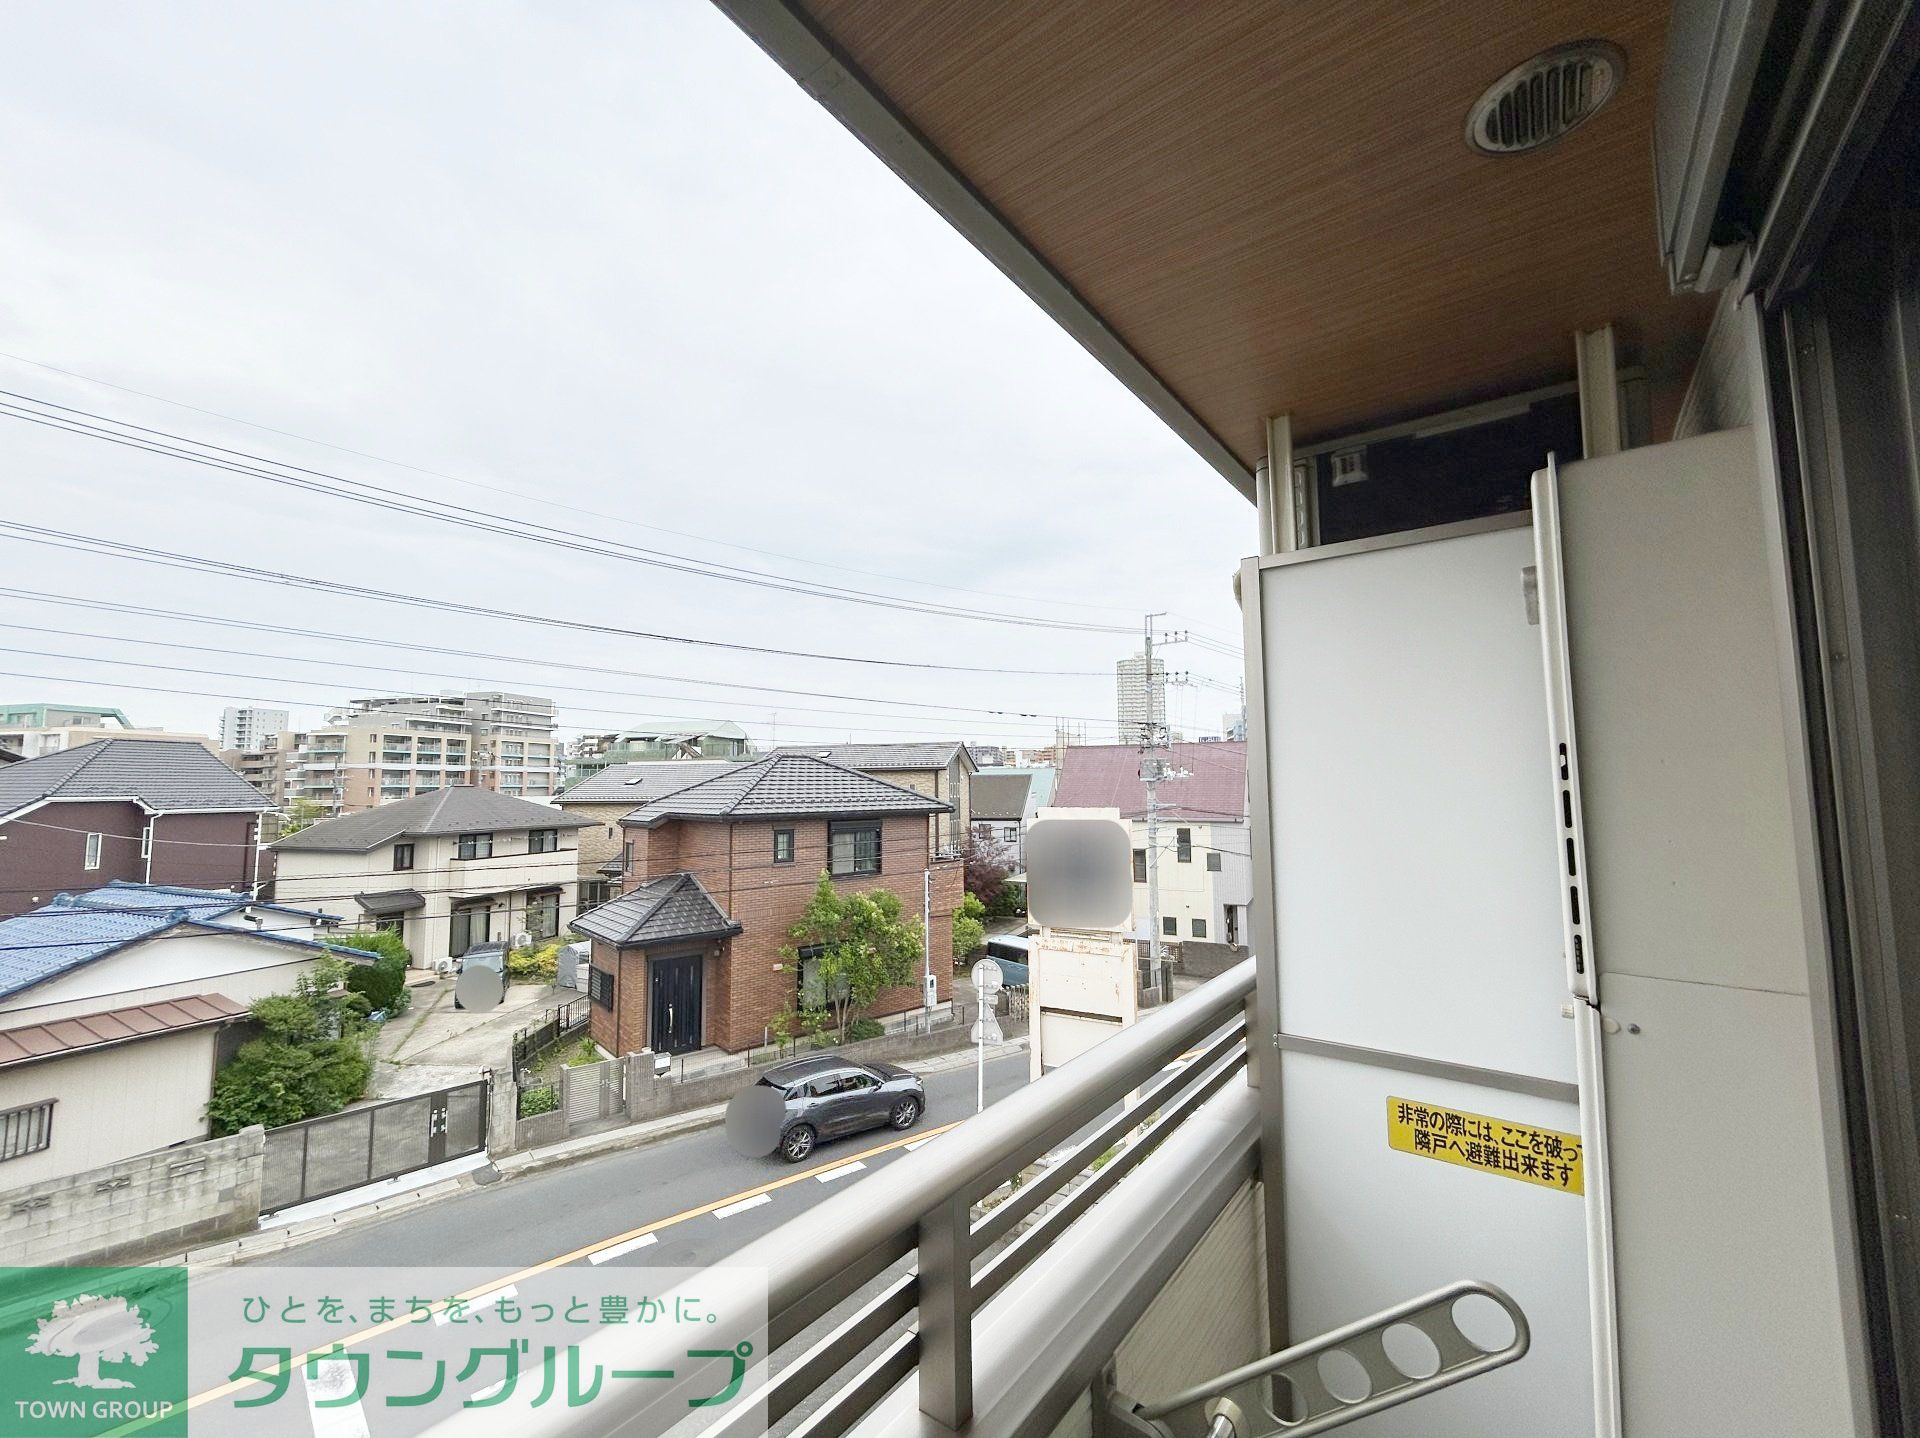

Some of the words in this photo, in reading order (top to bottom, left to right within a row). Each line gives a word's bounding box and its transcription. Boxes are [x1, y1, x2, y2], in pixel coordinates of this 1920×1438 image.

[1397, 1103, 1582, 1161] 非常の際には、ここを破っ
[1414, 1128, 1574, 1186] 隣戸へ避難出来ます
